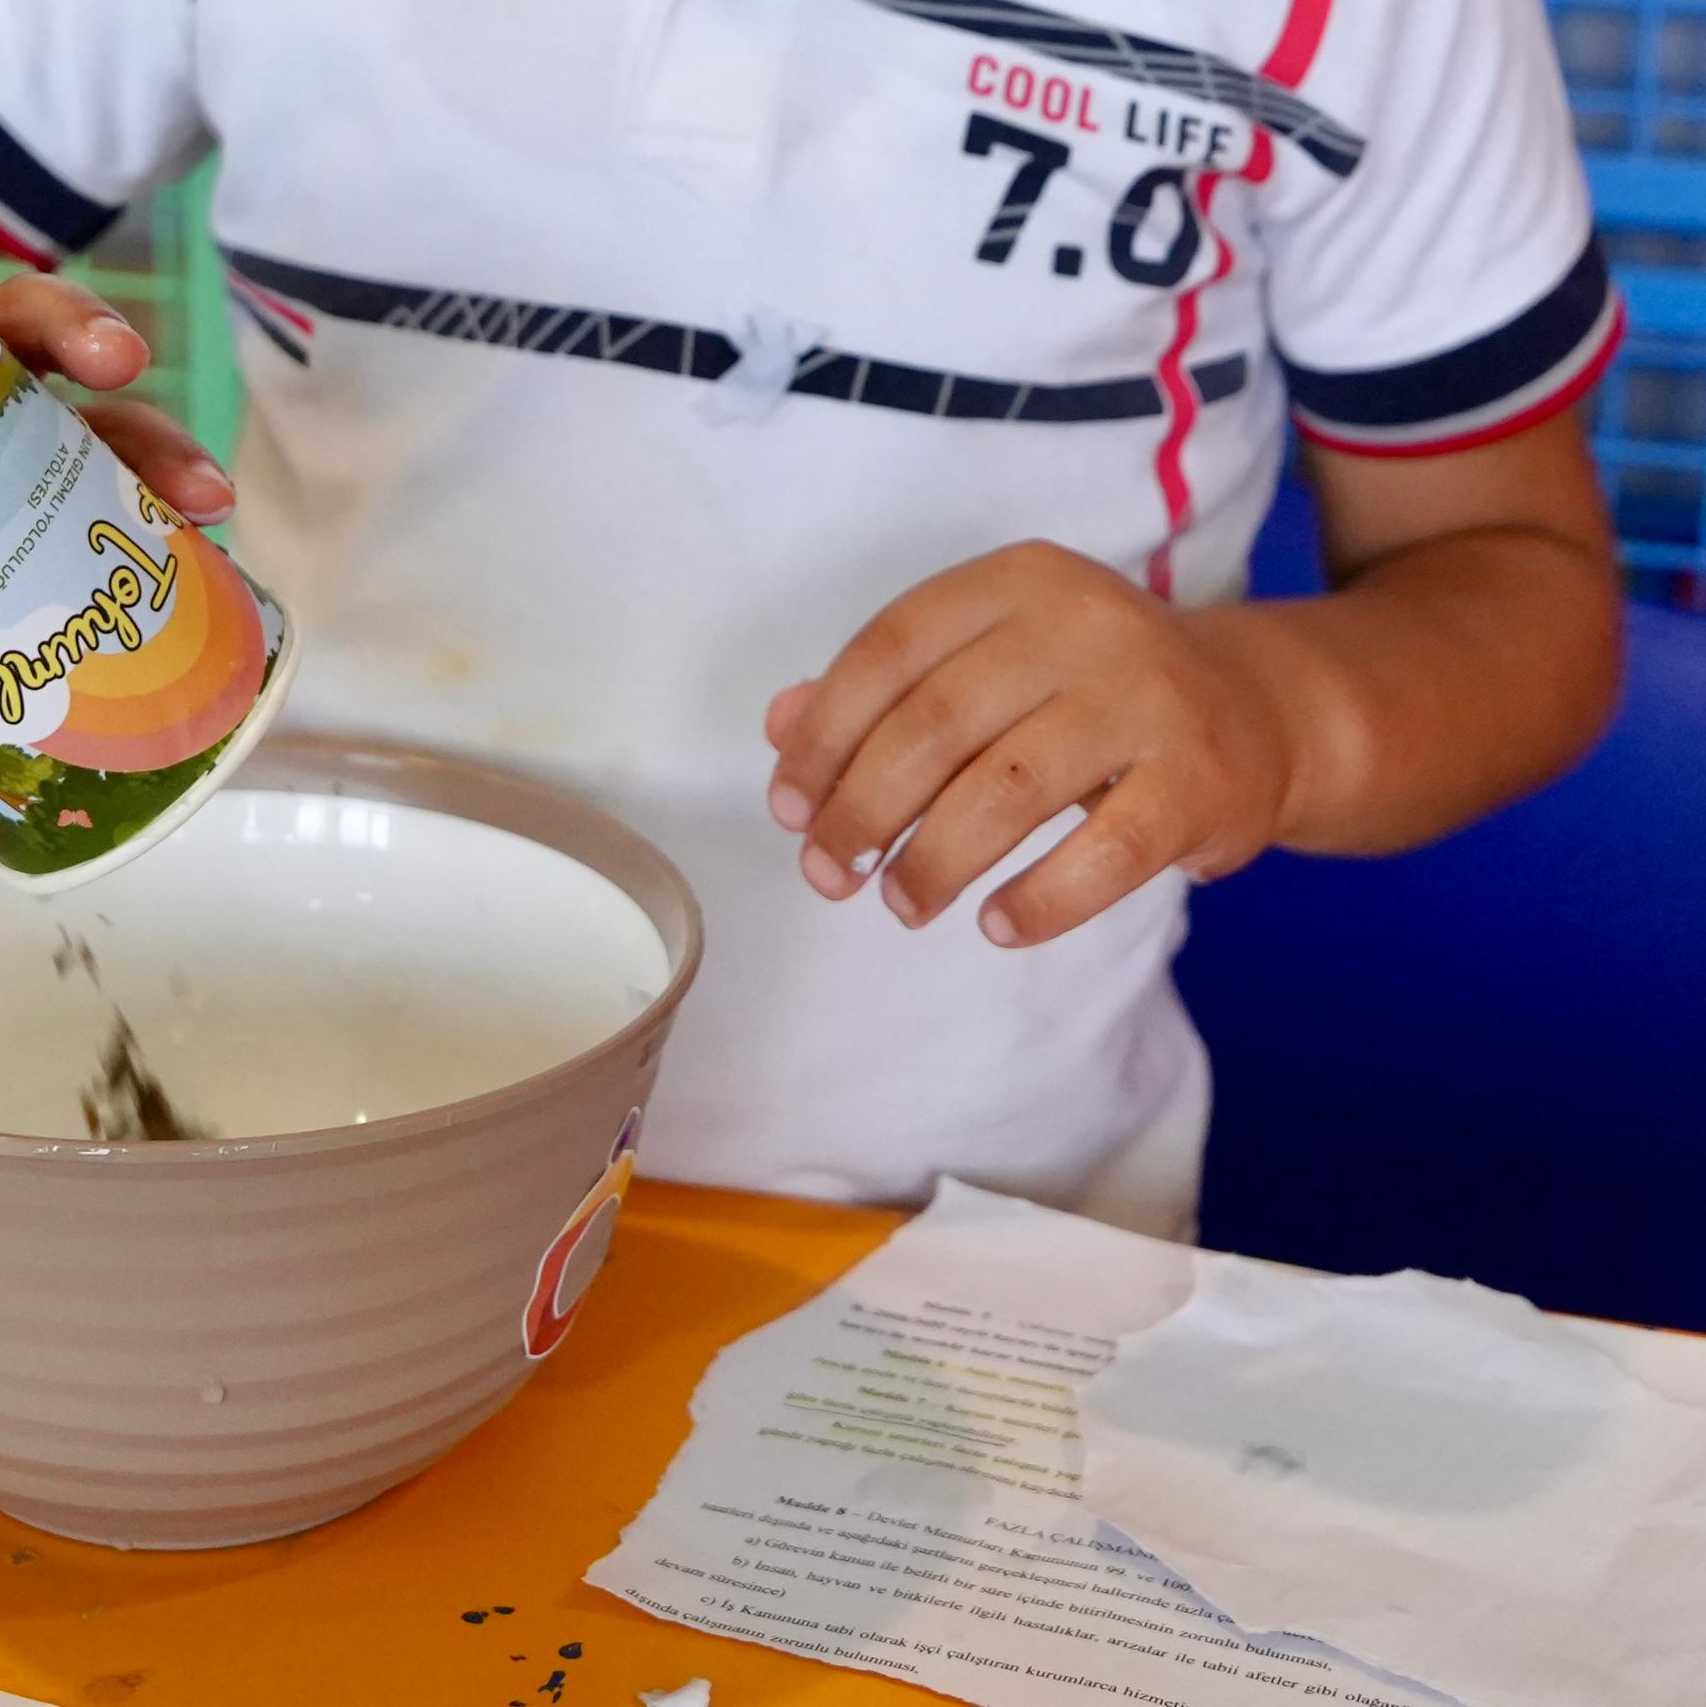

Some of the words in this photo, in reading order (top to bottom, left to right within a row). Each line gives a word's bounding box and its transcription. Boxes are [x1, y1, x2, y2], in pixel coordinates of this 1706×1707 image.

[968, 54, 1102, 135] COOL
[1123, 99, 1232, 166] LIFE
[961, 111, 1201, 288] 7.0
[654, 1556, 706, 1578] devam
[708, 1571, 787, 1598] süresince)
[700, 1501, 754, 1520] saatleri
[758, 1513, 812, 1533] dışında
[818, 1526, 835, 1536] ve
[837, 1529, 908, 1551] aşağıdaki
[912, 1544, 975, 1568] şartların
[977, 1562, 1087, 1591] gerçekleşmesi
[1091, 1583, 1171, 1609] hallerinde
[1174, 1602, 1213, 1620] fazla
[775, 1495, 831, 1514] Madde
[866, 1511, 918, 1531] Devlet
[924, 1525, 1003, 1553] Memurları
[1010, 1547, 1099, 1572] Kanununun
[1137, 1573, 1154, 1583] ve
[984, 1516, 1045, 1540] FAZLA
[624, 1586, 679, 1617] dışında
[682, 1610, 766, 1641] çalışmanın
[769, 1634, 830, 1655] zorunlu
[700, 1595, 717, 1607] c)
[740, 1604, 820, 1631] Kanununa
[824, 1620, 854, 1638] tabi
[859, 1629, 907, 1649] olarak
[913, 1639, 941, 1656] işçi
[946, 1647, 1020, 1674] çalıştıran
[1025, 1665, 1118, 1694] kurumlarca
[731, 1555, 749, 1569] b)
[805, 1570, 862, 1592] hayvan
[868, 1585, 887, 1596] ve
[893, 1586, 964, 1611] bitkilerle
[969, 1604, 1007, 1623] ilgili
[1013, 1614, 1100, 1643] hastalıklar,
[1106, 1635, 1169, 1658] arızalar
[1174, 1651, 1196, 1665] ile
[1202, 1659, 1240, 1676] tabii
[1245, 1669, 1299, 1689] afetler
[1303, 1682, 1339, 1699] gibi
[744, 1535, 761, 1548] a)
[764, 1537, 826, 1559] Görevin
[829, 1550, 876, 1568] kanun
[880, 1560, 900, 1573] ile
[902, 1565, 950, 1585] belirli
[953, 1577, 976, 1591] bir
[980, 1583, 1014, 1600] süre
[1016, 1592, 1065, 1611] içinde
[1069, 1602, 1175, 1637] bitirilmesinin
[1178, 1629, 1241, 1652] zorunlu
[1245, 1642, 1333, 1672] bulunması,
